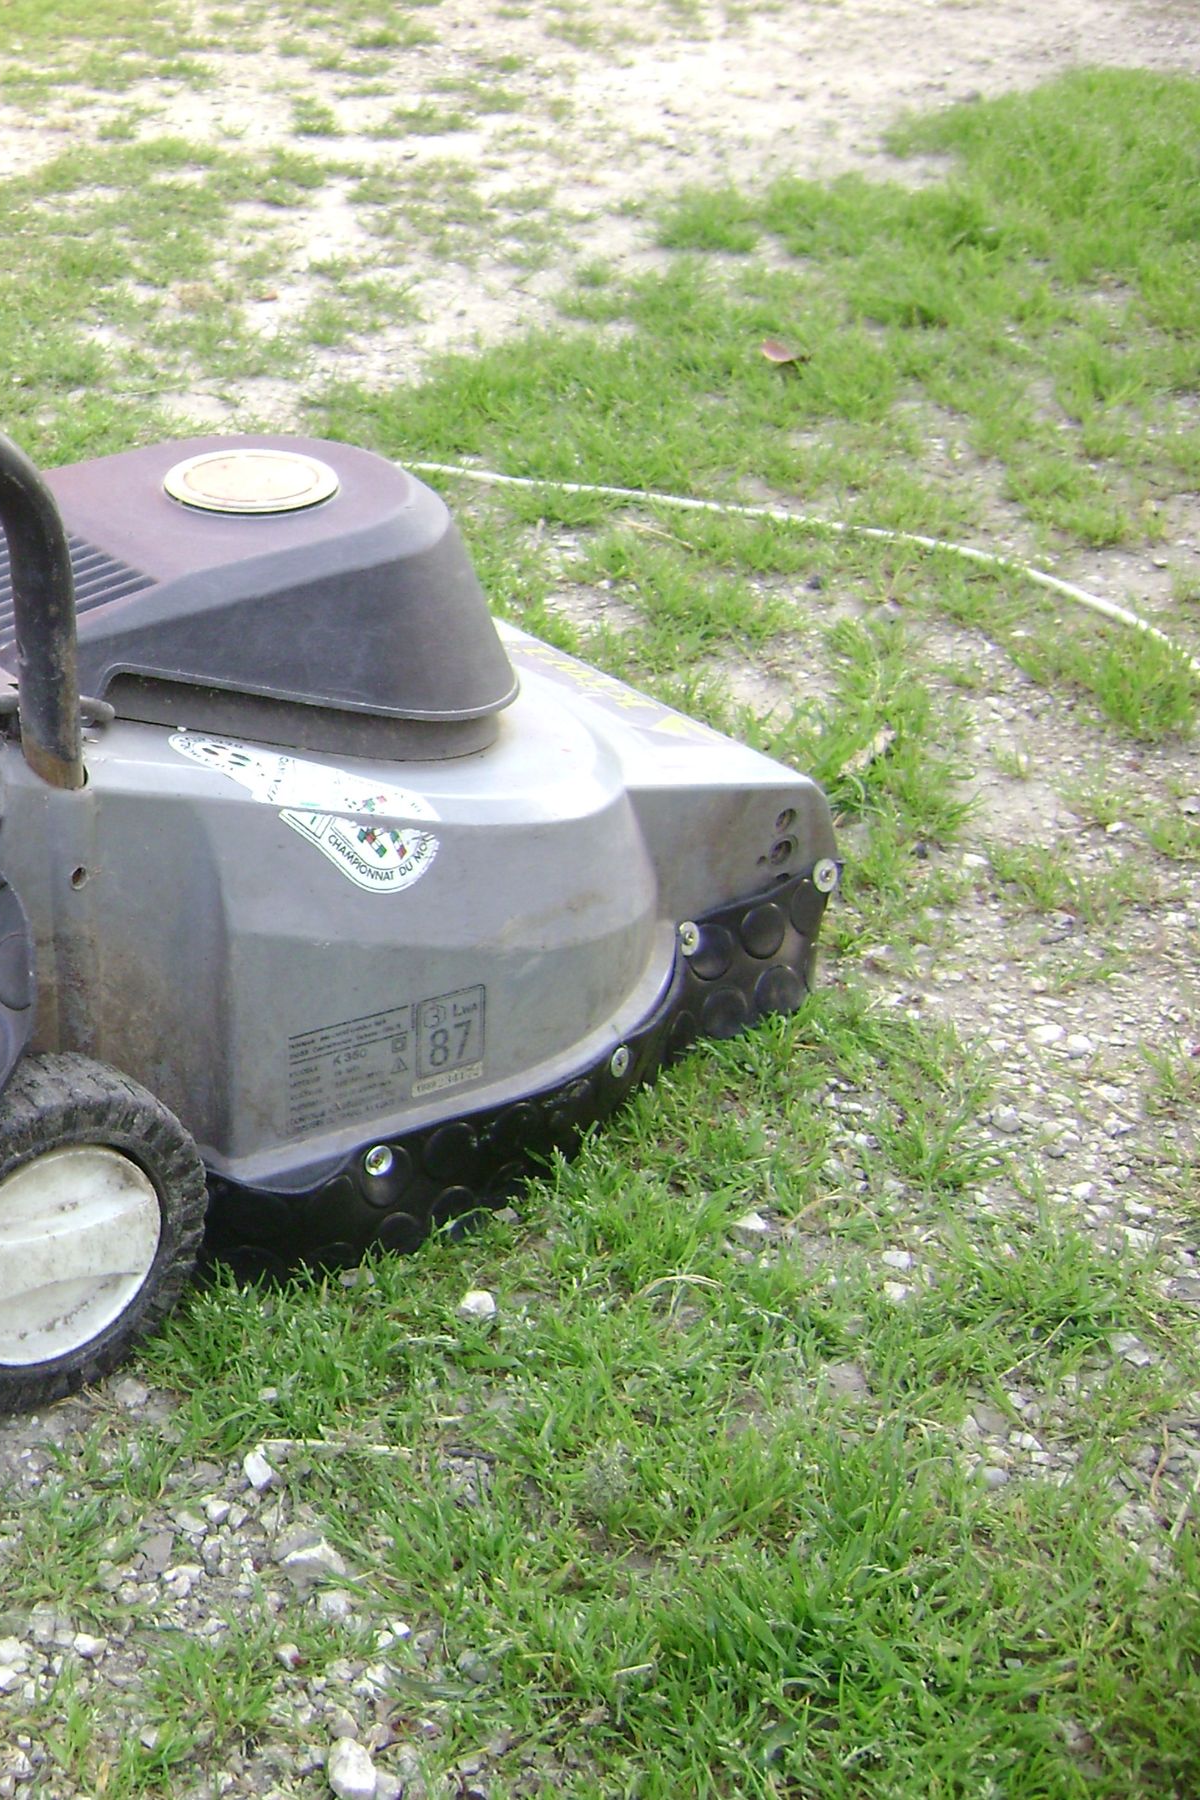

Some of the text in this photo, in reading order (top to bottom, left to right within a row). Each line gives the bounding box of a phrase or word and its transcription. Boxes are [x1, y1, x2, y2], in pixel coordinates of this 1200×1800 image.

[327, 834, 394, 881] CHAMPIONNAT
[399, 861, 413, 876] DU
[430, 1020, 471, 1066] 87
